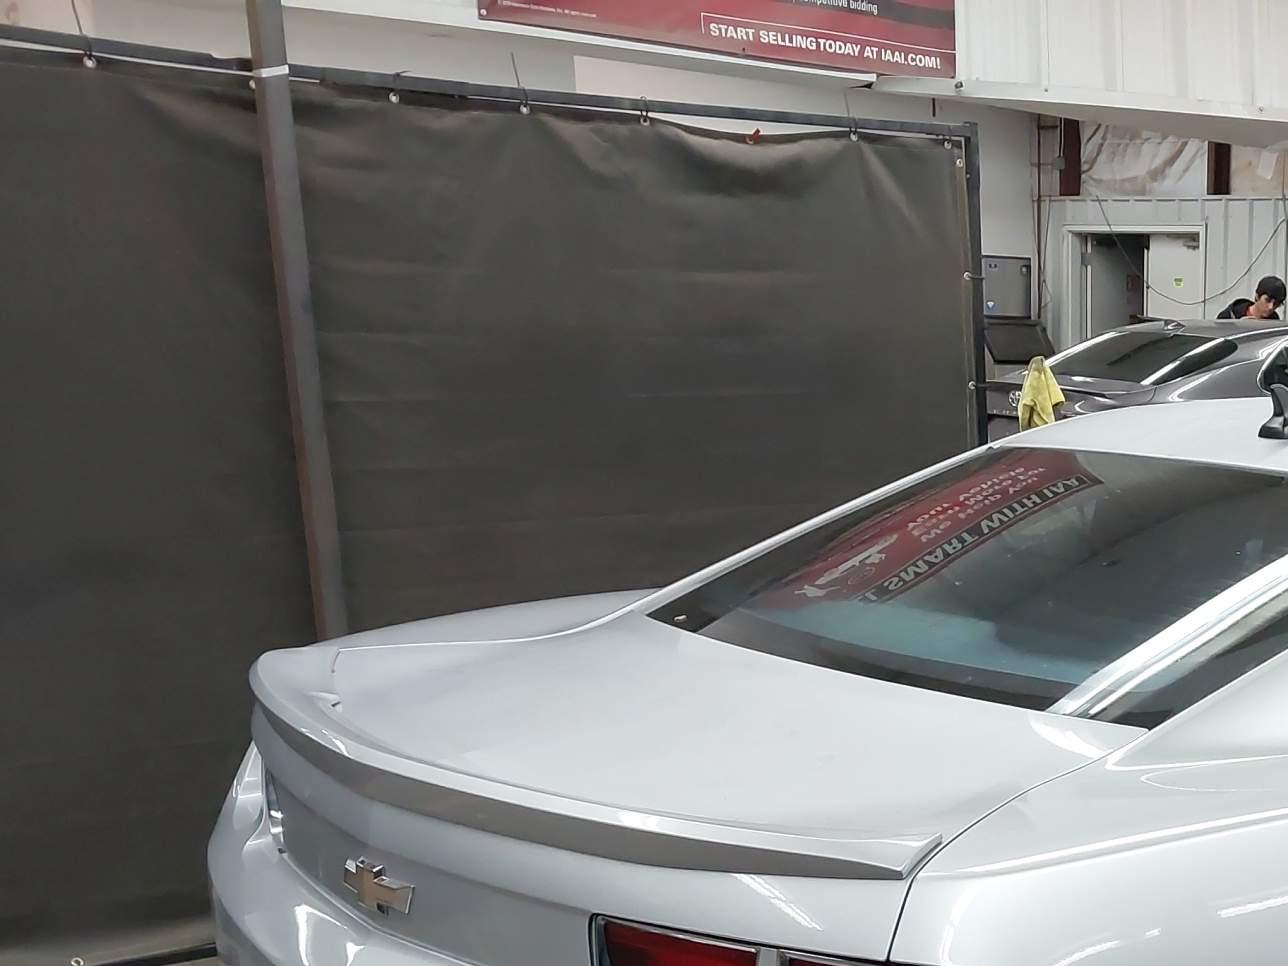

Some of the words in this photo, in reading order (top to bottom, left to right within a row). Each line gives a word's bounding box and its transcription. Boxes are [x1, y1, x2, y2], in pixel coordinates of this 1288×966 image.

[849, 0, 878, 15] bidding
[709, 23, 755, 41] START
[759, 30, 817, 51] SELLING
[818, 38, 862, 57] TODAY
[863, 47, 879, 60] AT
[880, 47, 941, 69] IAAI.COM!
